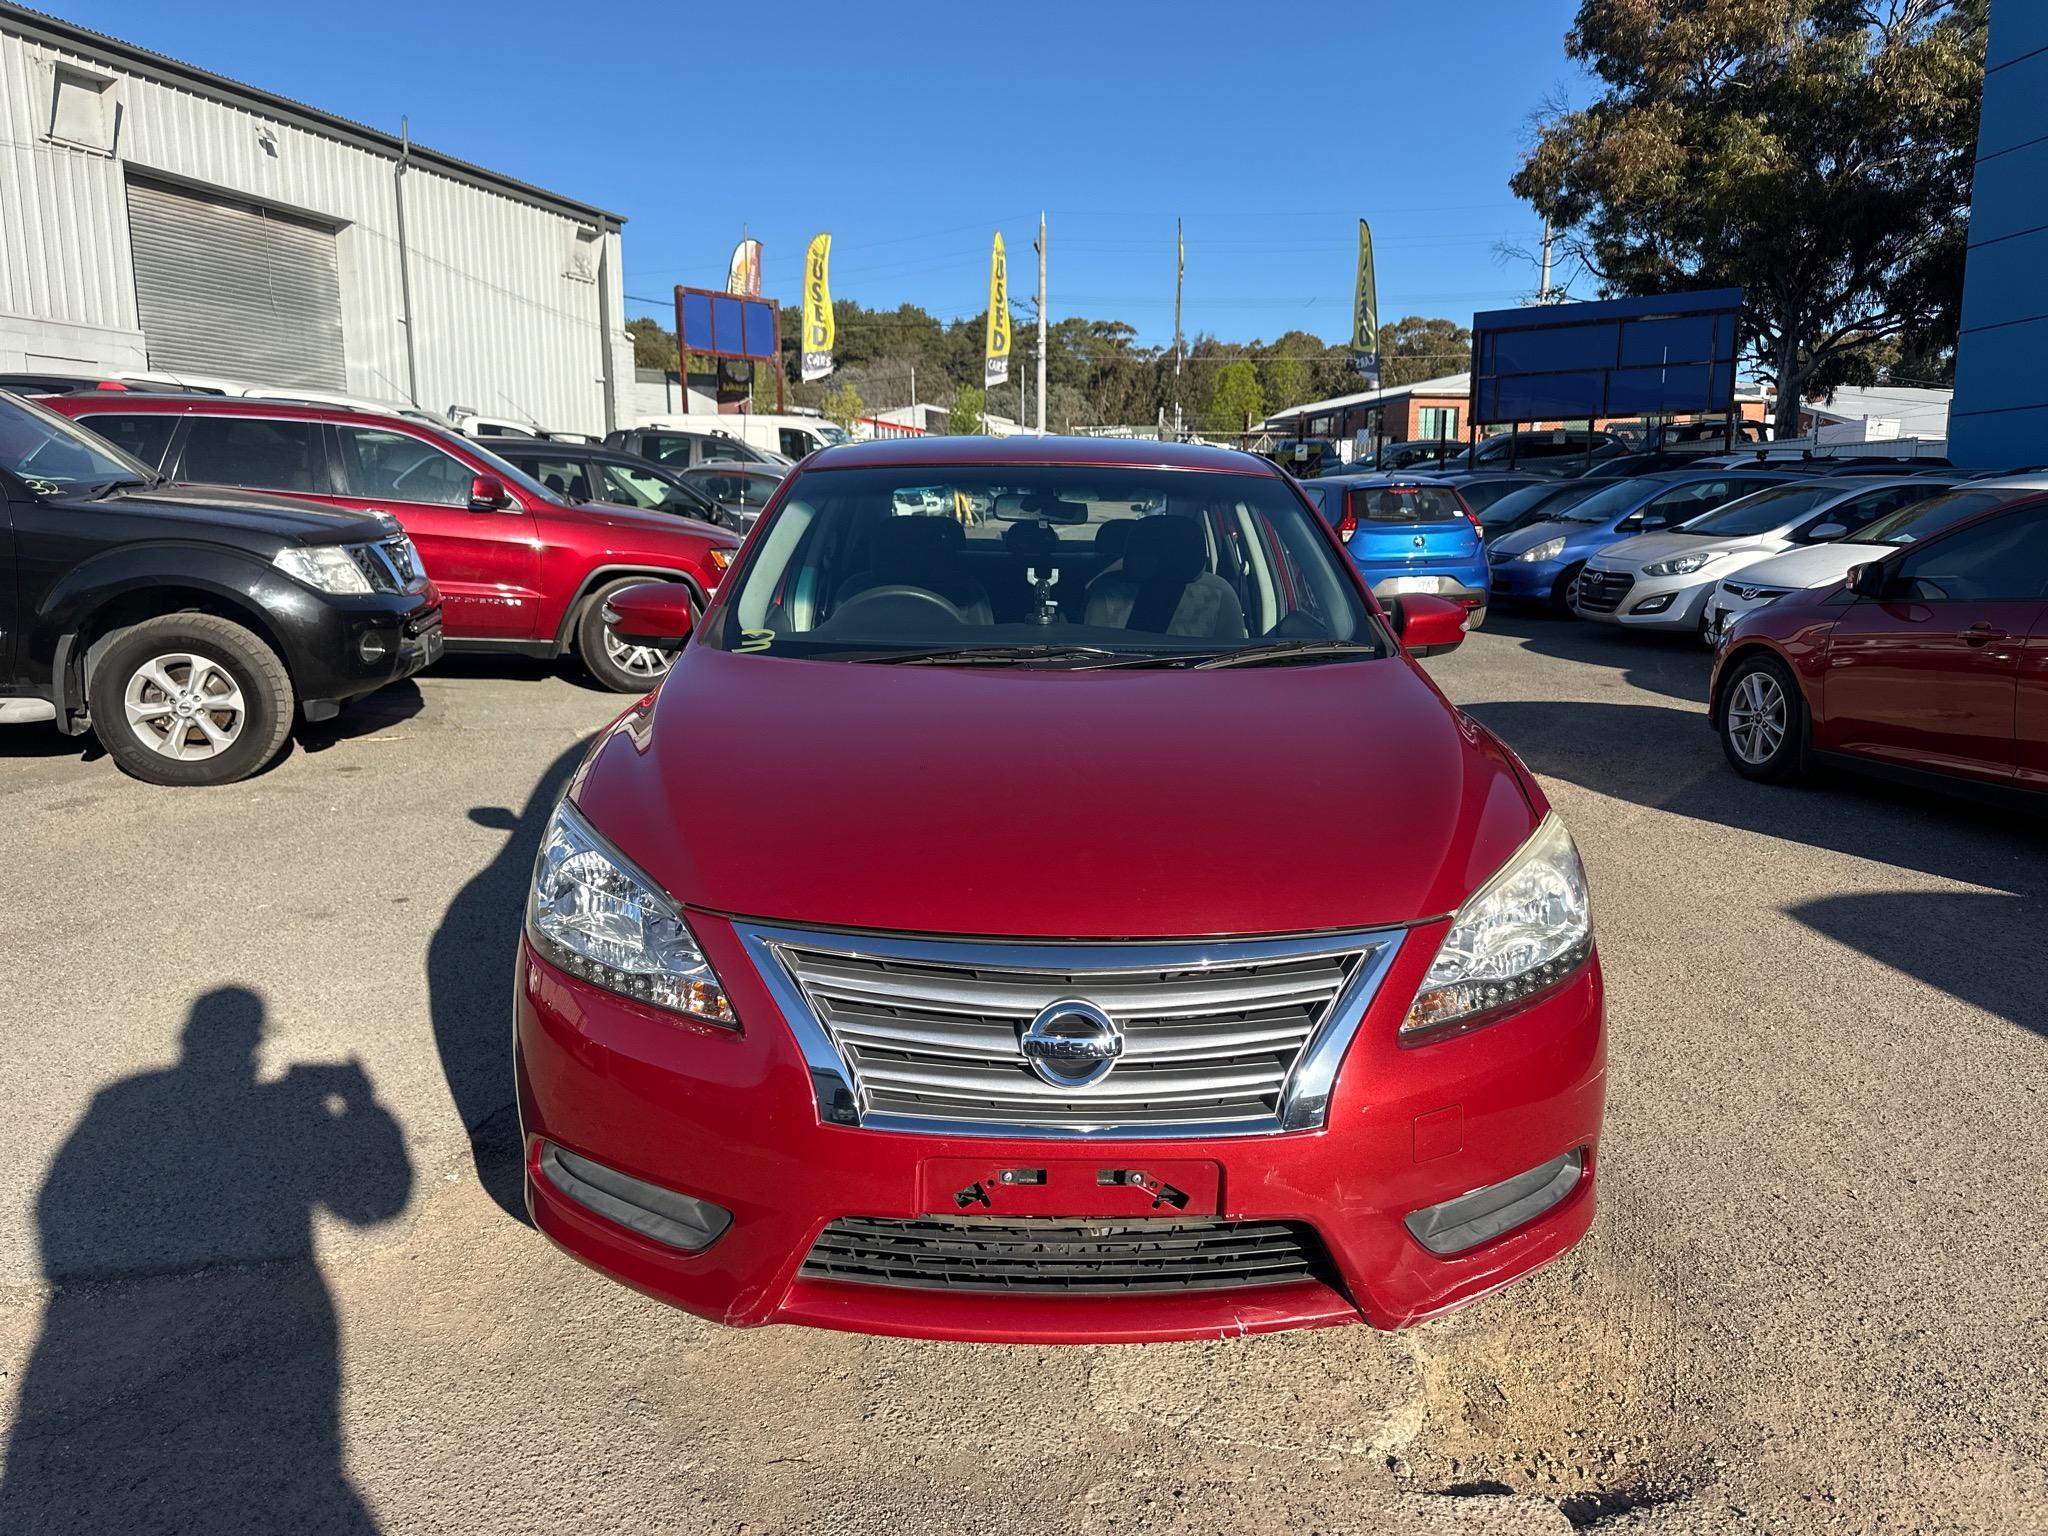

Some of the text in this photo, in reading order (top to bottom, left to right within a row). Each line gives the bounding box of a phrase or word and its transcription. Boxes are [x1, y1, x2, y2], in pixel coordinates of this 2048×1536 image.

[812, 258, 828, 347] USED
[993, 259, 1006, 351] USED
[806, 353, 832, 368] CARS
[988, 358, 1007, 373] CARS
[1032, 1040, 1113, 1058] NISSAN
